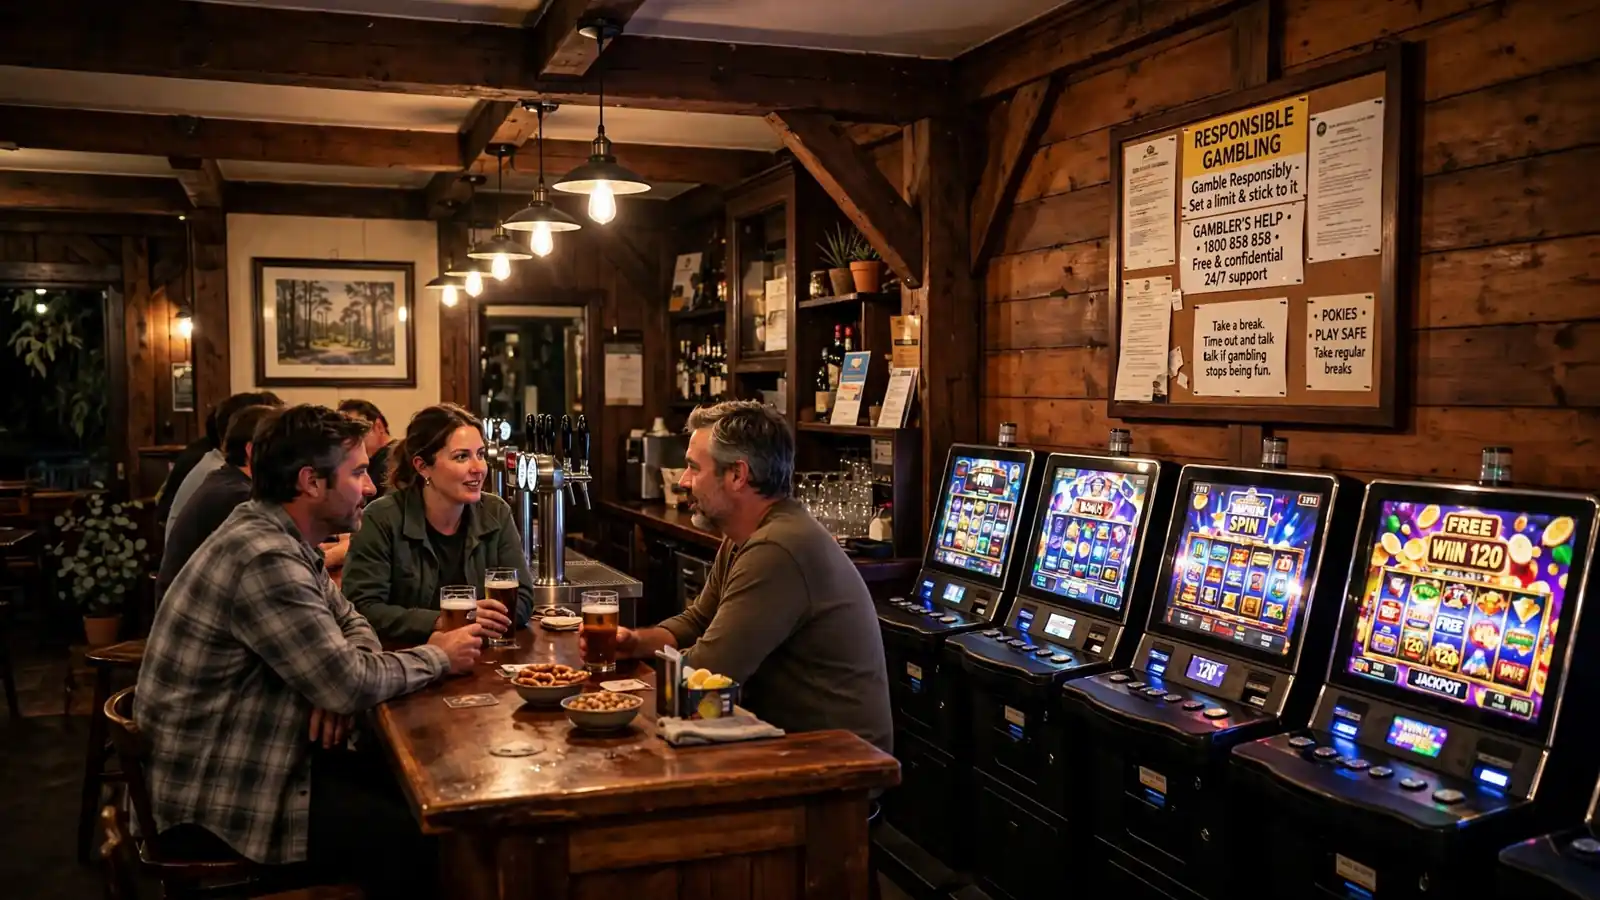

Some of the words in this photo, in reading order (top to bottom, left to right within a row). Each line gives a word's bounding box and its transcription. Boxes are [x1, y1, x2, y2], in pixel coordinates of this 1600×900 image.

[1194, 106, 1294, 148] RESPONSIBLE
[1202, 133, 1281, 169] GAMBLING
[1191, 175, 1227, 194] Gamble
[1230, 161, 1292, 187] Responsibly
[1189, 198, 1205, 212] Set
[1206, 200, 1212, 208] a
[1214, 191, 1236, 208] limit
[1238, 189, 1246, 202] &
[1249, 184, 1274, 202] stick
[1276, 183, 1288, 197] to
[1290, 180, 1298, 194] it
[1193, 216, 1252, 238] GAMBLER'S
[1254, 211, 1284, 229] HELP
[1203, 238, 1227, 253] 1800
[1229, 235, 1249, 249] 858
[1251, 231, 1272, 246] 858
[1192, 257, 1212, 271] Free
[1214, 254, 1222, 268] &
[1224, 245, 1284, 267] confidential
[1204, 271, 1226, 286] 24/7
[1228, 267, 1268, 286] support
[1322, 307, 1358, 322] POKIES
[1212, 320, 1231, 332] Take
[1232, 322, 1238, 331] a
[1239, 318, 1265, 330] break.
[1315, 328, 1340, 341] PLAY
[1341, 326, 1367, 340] SAFE
[1203, 336, 1223, 347] Time
[1224, 335, 1238, 347] out
[1239, 333, 1256, 345] and
[1257, 332, 1275, 345] talk
[1203, 350, 1219, 362] talk
[1220, 350, 1227, 362] if
[1227, 348, 1267, 364] gambling
[1314, 346, 1333, 358] Take
[1334, 345, 1366, 361] regular
[1205, 366, 1228, 379] stops
[1229, 364, 1252, 379] being
[1254, 363, 1271, 376] fun.
[1324, 361, 1353, 375] breaks
[1229, 515, 1260, 534] SPIN
[1447, 516, 1493, 536] FREE
[1470, 543, 1504, 569] 120
[1436, 615, 1465, 634] FREE
[1403, 637, 1425, 653] 120
[1435, 647, 1460, 666] 120
[1415, 673, 1461, 694] JACKPOT
